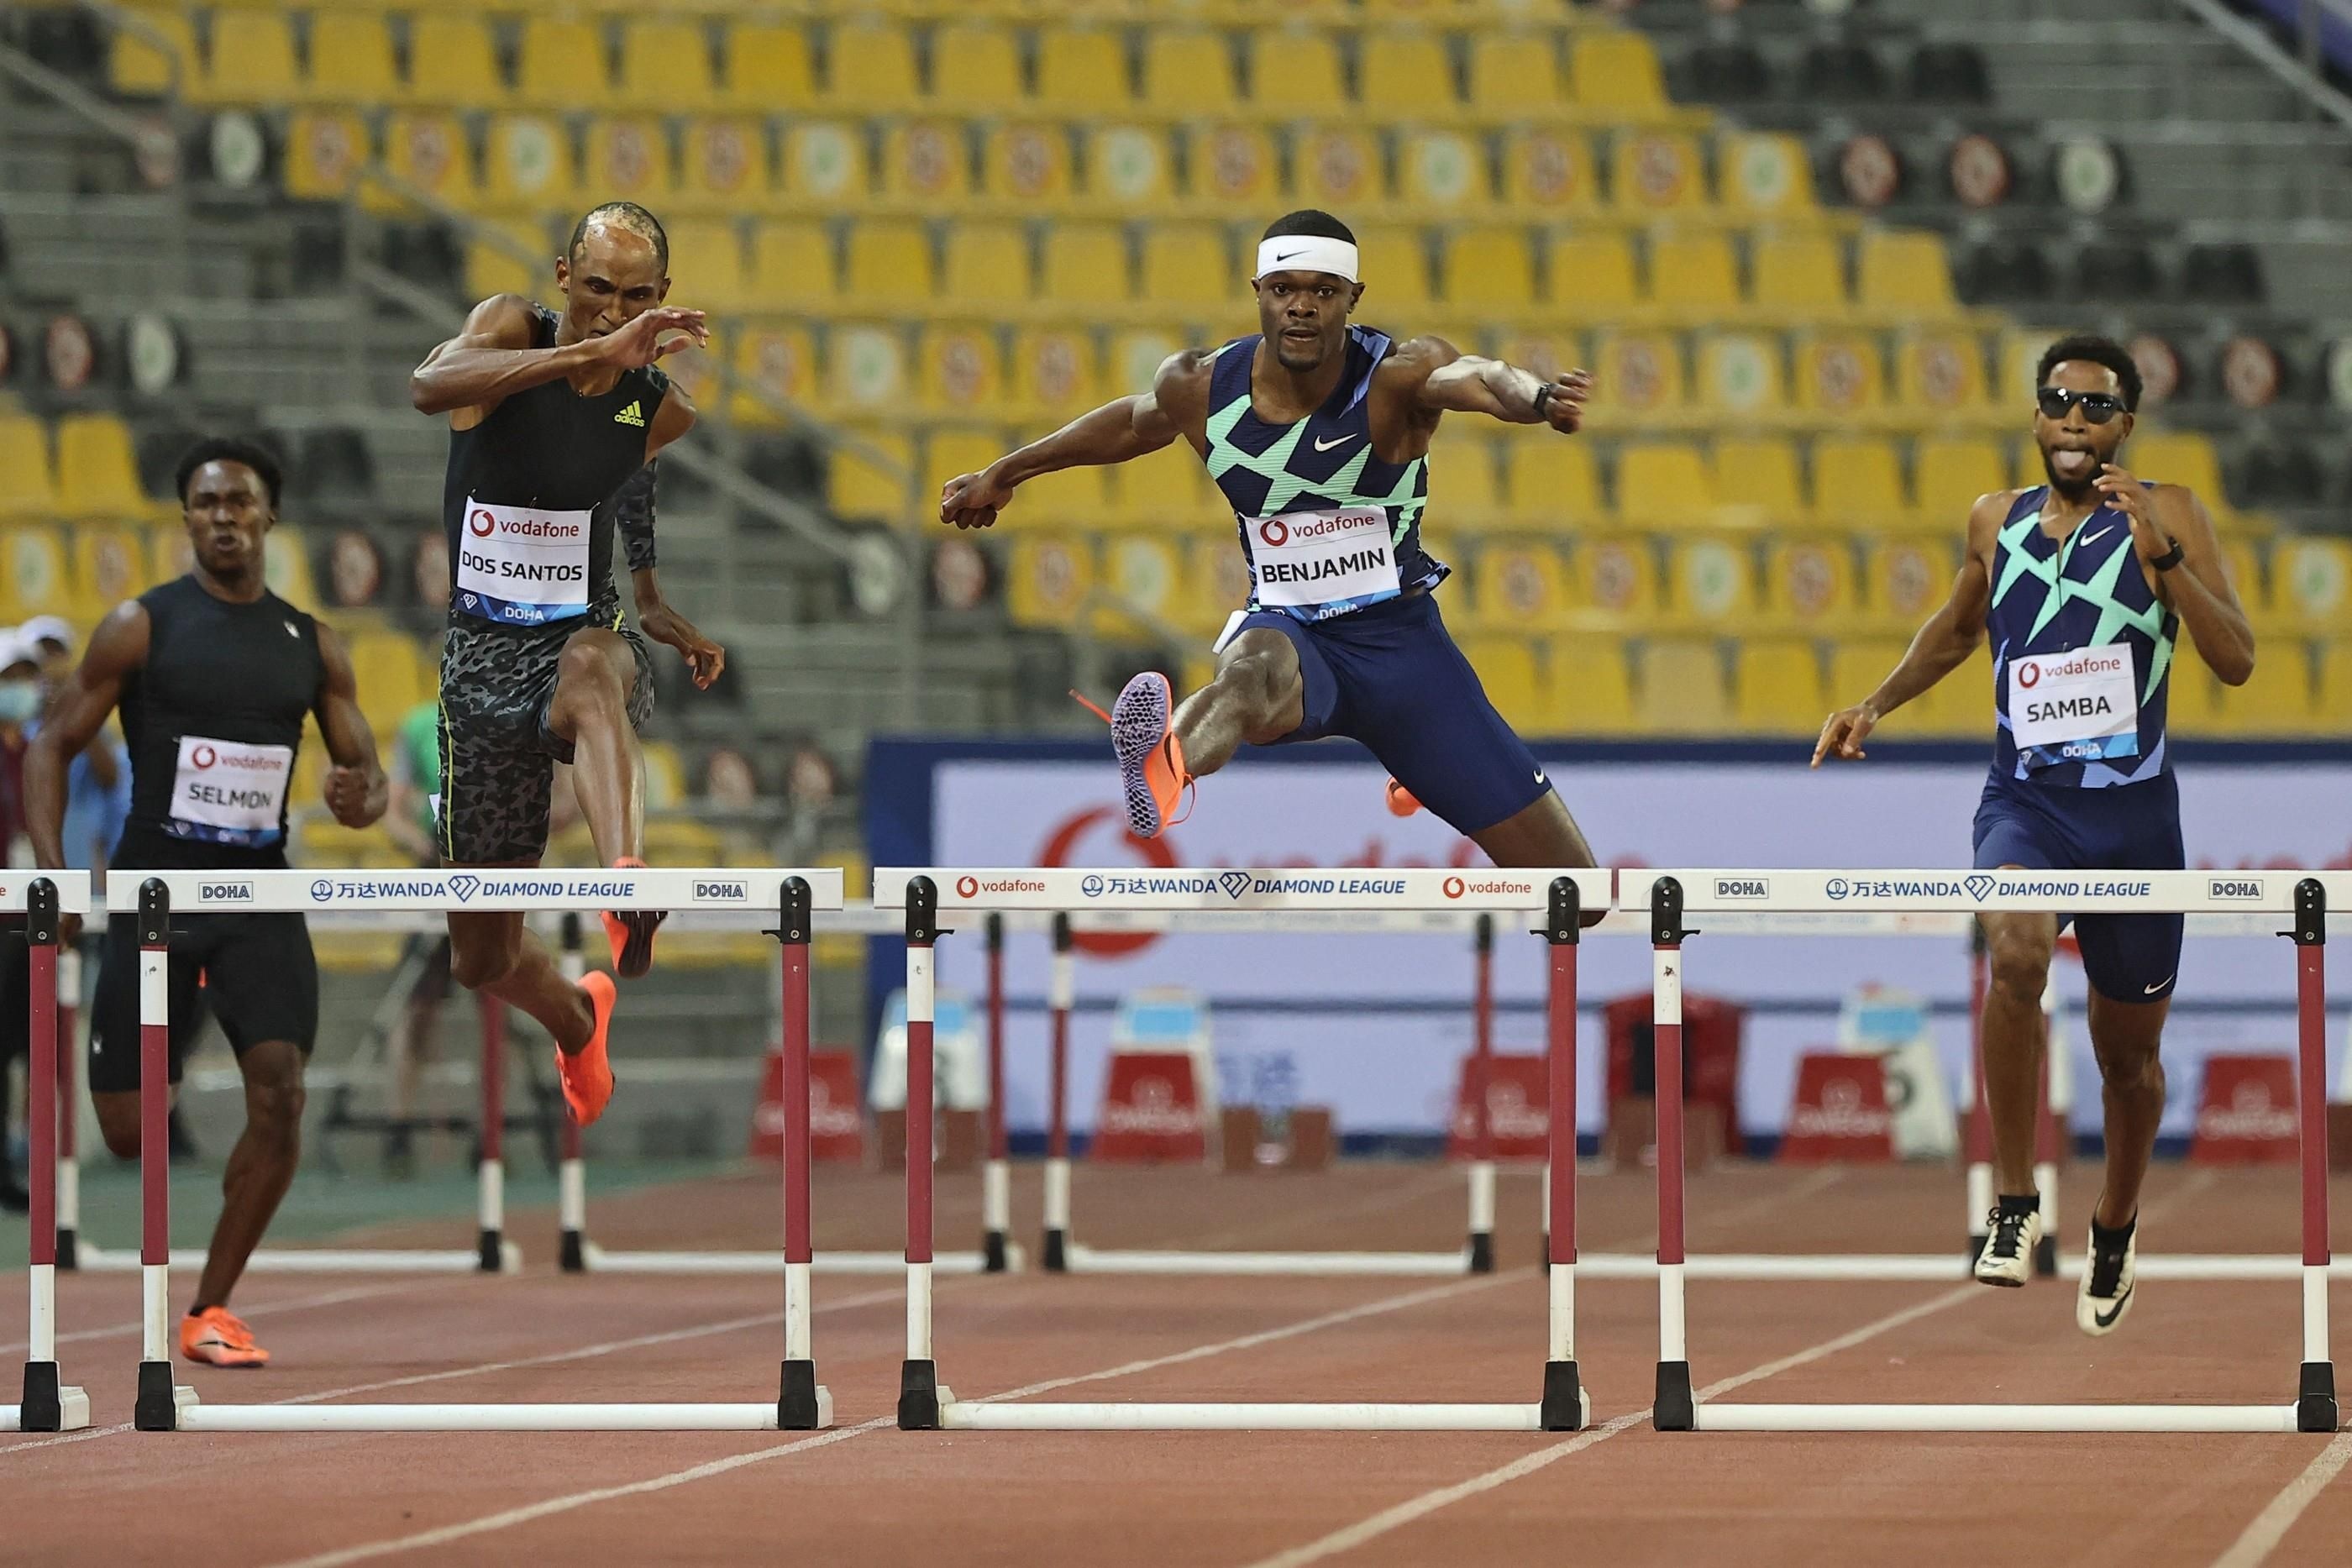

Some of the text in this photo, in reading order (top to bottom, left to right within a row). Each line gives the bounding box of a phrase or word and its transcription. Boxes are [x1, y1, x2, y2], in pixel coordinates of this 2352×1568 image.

[614, 414, 645, 427] adidas
[500, 520, 580, 538] vodafone
[1293, 516, 1375, 538] vodafone
[462, 550, 583, 581] DOS SANTOS
[1261, 548, 1385, 584] BENJAMIN
[505, 606, 545, 621] DOHA
[2045, 657, 2121, 678] vodafone
[2027, 695, 2112, 723] SAMBA
[2062, 742, 2102, 758] DOHA
[188, 782, 273, 810] SELMON
[202, 885, 250, 899] DOHA
[482, 883, 564, 897] DIAMOND
[567, 883, 635, 897] LEAGUE
[696, 884, 743, 898] DOHA
[982, 879, 1045, 892] vodafone
[1253, 879, 1335, 894] DIAMOND
[1339, 879, 1406, 894] LEAGUE
[1468, 880, 1532, 894] vodafone
[1718, 882, 1765, 895] DOHA
[1998, 883, 2079, 897] DIAMOND
[2083, 883, 2151, 897] LEAGUE
[2212, 883, 2260, 897] DOHA
